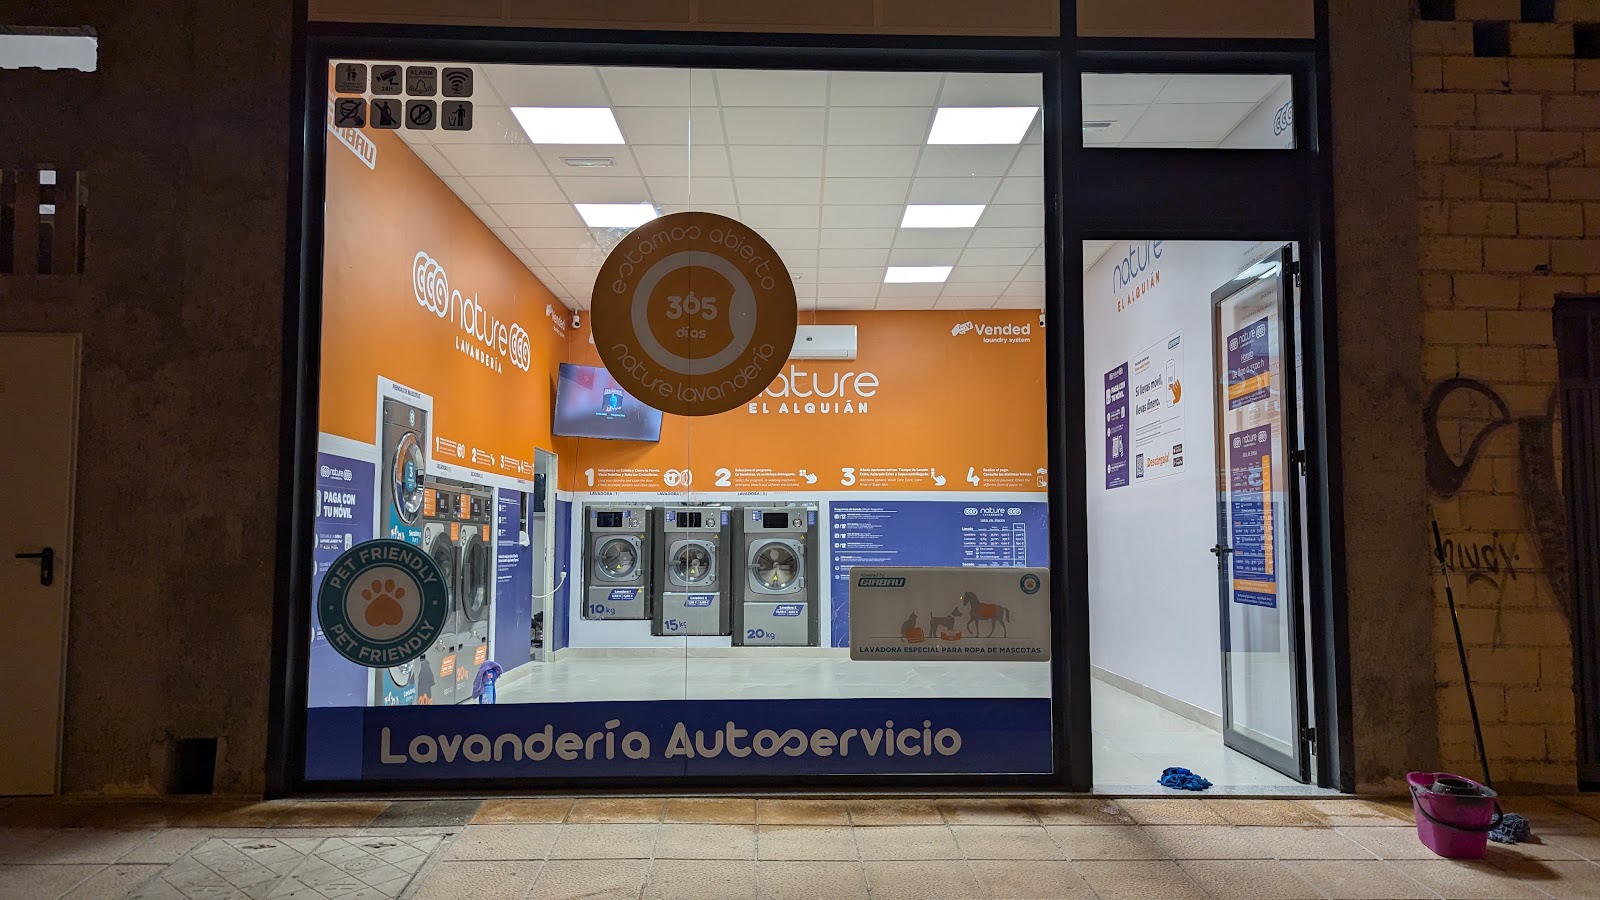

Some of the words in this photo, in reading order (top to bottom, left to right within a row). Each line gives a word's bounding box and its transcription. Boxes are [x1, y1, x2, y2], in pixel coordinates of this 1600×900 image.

[709, 228, 775, 290] abierto
[1117, 300, 1125, 313] EL
[1127, 270, 1160, 306] ALQUIÁN
[666, 290, 718, 320] 365
[450, 289, 508, 356] nature
[973, 322, 1031, 336] Vended
[676, 326, 706, 339] días
[1239, 328, 1255, 345] nature
[455, 336, 502, 374] LAVANDERÍA
[612, 343, 674, 398] nature
[676, 343, 776, 402] lavandería
[757, 364, 879, 398] ature
[749, 402, 769, 414] EL
[778, 400, 869, 414] ALQUIÁN
[436, 436, 439, 452] 1
[472, 448, 476, 462] 2
[500, 455, 504, 468] 3
[585, 468, 595, 486] 1
[715, 468, 731, 486] 2
[841, 468, 856, 486] 3
[967, 466, 980, 486] 4
[324, 490, 342, 504] PAGA
[342, 494, 356, 506] CON
[324, 506, 332, 518] TU
[334, 504, 352, 519] MÓVIL
[330, 558, 357, 590] PET
[358, 546, 437, 585] FRIENDLY
[590, 604, 604, 614] 10
[606, 607, 615, 615] kg
[664, 619, 678, 631] 15
[330, 623, 359, 654] PET
[358, 619, 435, 663] FRIENDLY
[747, 629, 764, 639] 20
[766, 632, 775, 640] kg
[380, 720, 650, 764] Lavandería
[665, 720, 962, 760] Autoservicio
